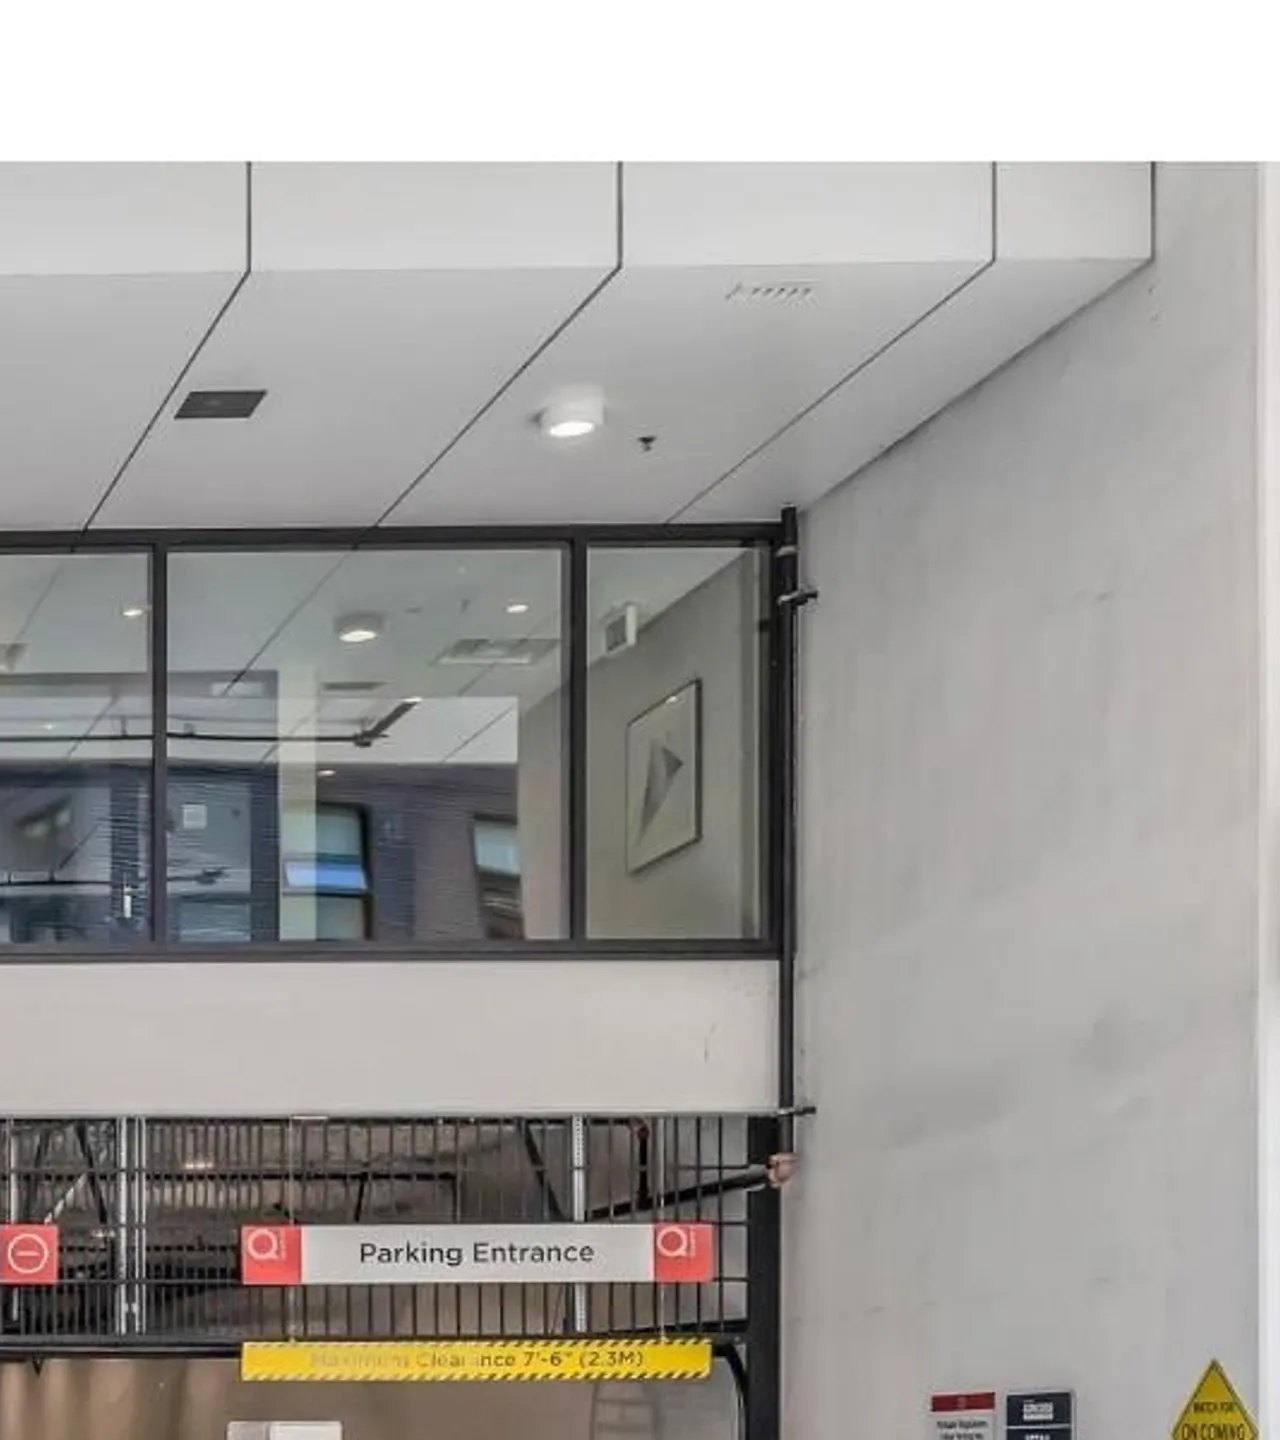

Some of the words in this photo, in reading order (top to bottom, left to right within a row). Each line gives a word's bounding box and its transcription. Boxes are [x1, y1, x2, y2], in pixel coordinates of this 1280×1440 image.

[360, 1242, 463, 1267] Parking
[474, 1242, 594, 1264] Entrance
[579, 1351, 643, 1369] (2.3M)
[1181, 1423, 1197, 1440] ON
[1200, 1423, 1245, 1440] COMING
